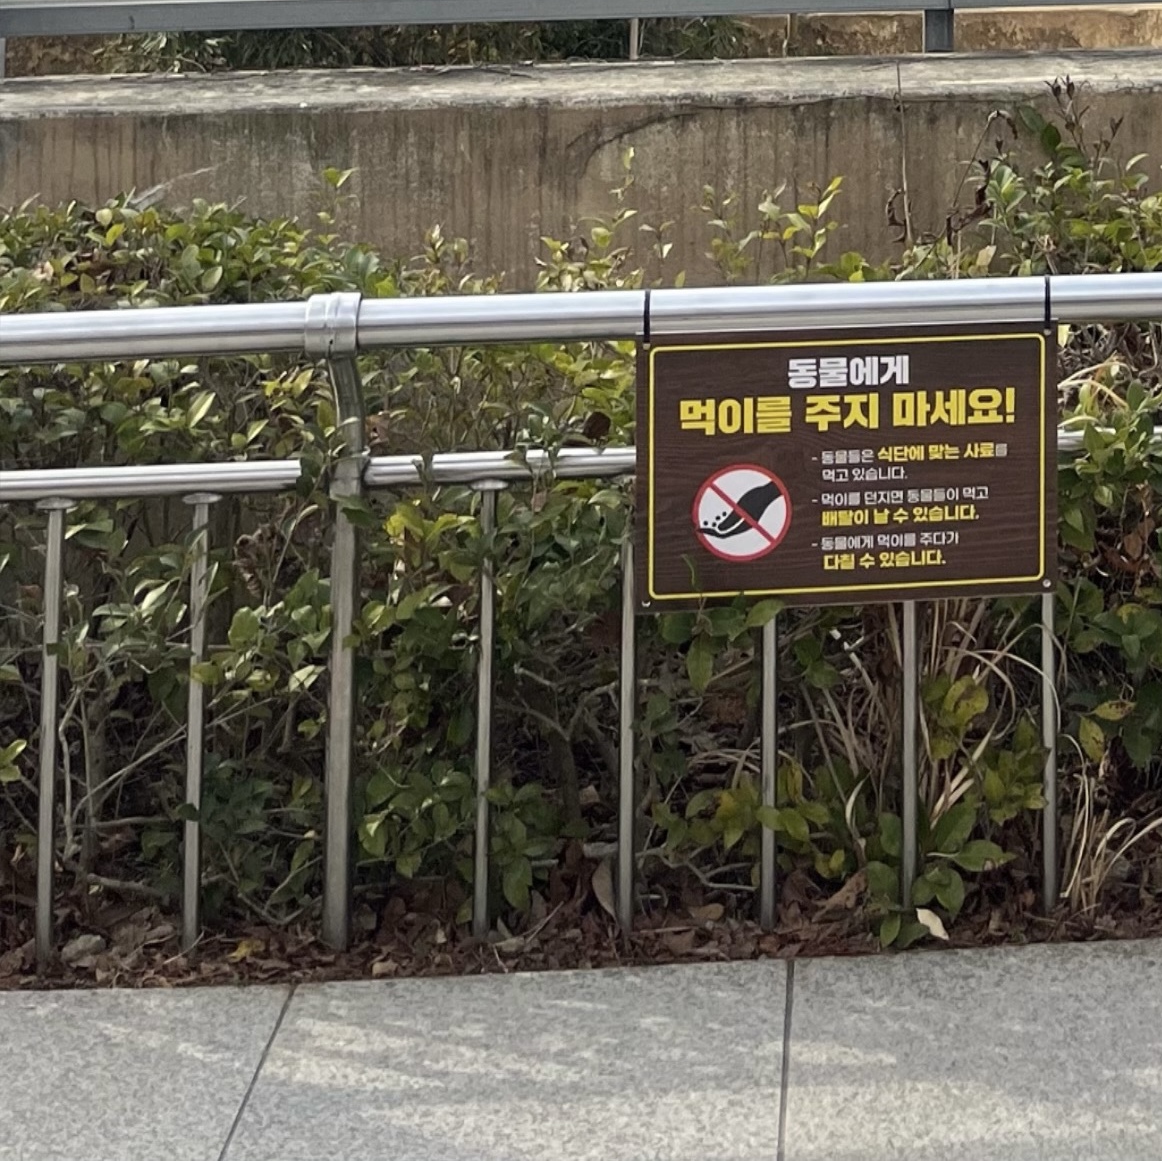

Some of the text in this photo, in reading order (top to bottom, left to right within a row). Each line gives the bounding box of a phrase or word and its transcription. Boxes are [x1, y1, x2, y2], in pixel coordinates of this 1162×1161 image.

[788, 355, 909, 389] 동물에게
[680, 387, 1016, 436] 먹이를 주지 마세요!
[877, 445, 924, 462] 식단에
[928, 444, 960, 460] 맞는
[821, 466, 908, 482] 먹고 있습니다.
[821, 492, 860, 506] 먹이를
[864, 490, 904, 505] 던지면
[962, 486, 989, 500] 먹고
[821, 504, 979, 527] 배탈이 날 수 있습니다.
[821, 531, 959, 551] 동물에게 먹이를 주다가
[823, 549, 946, 570] 다칠 수 있습니다.
